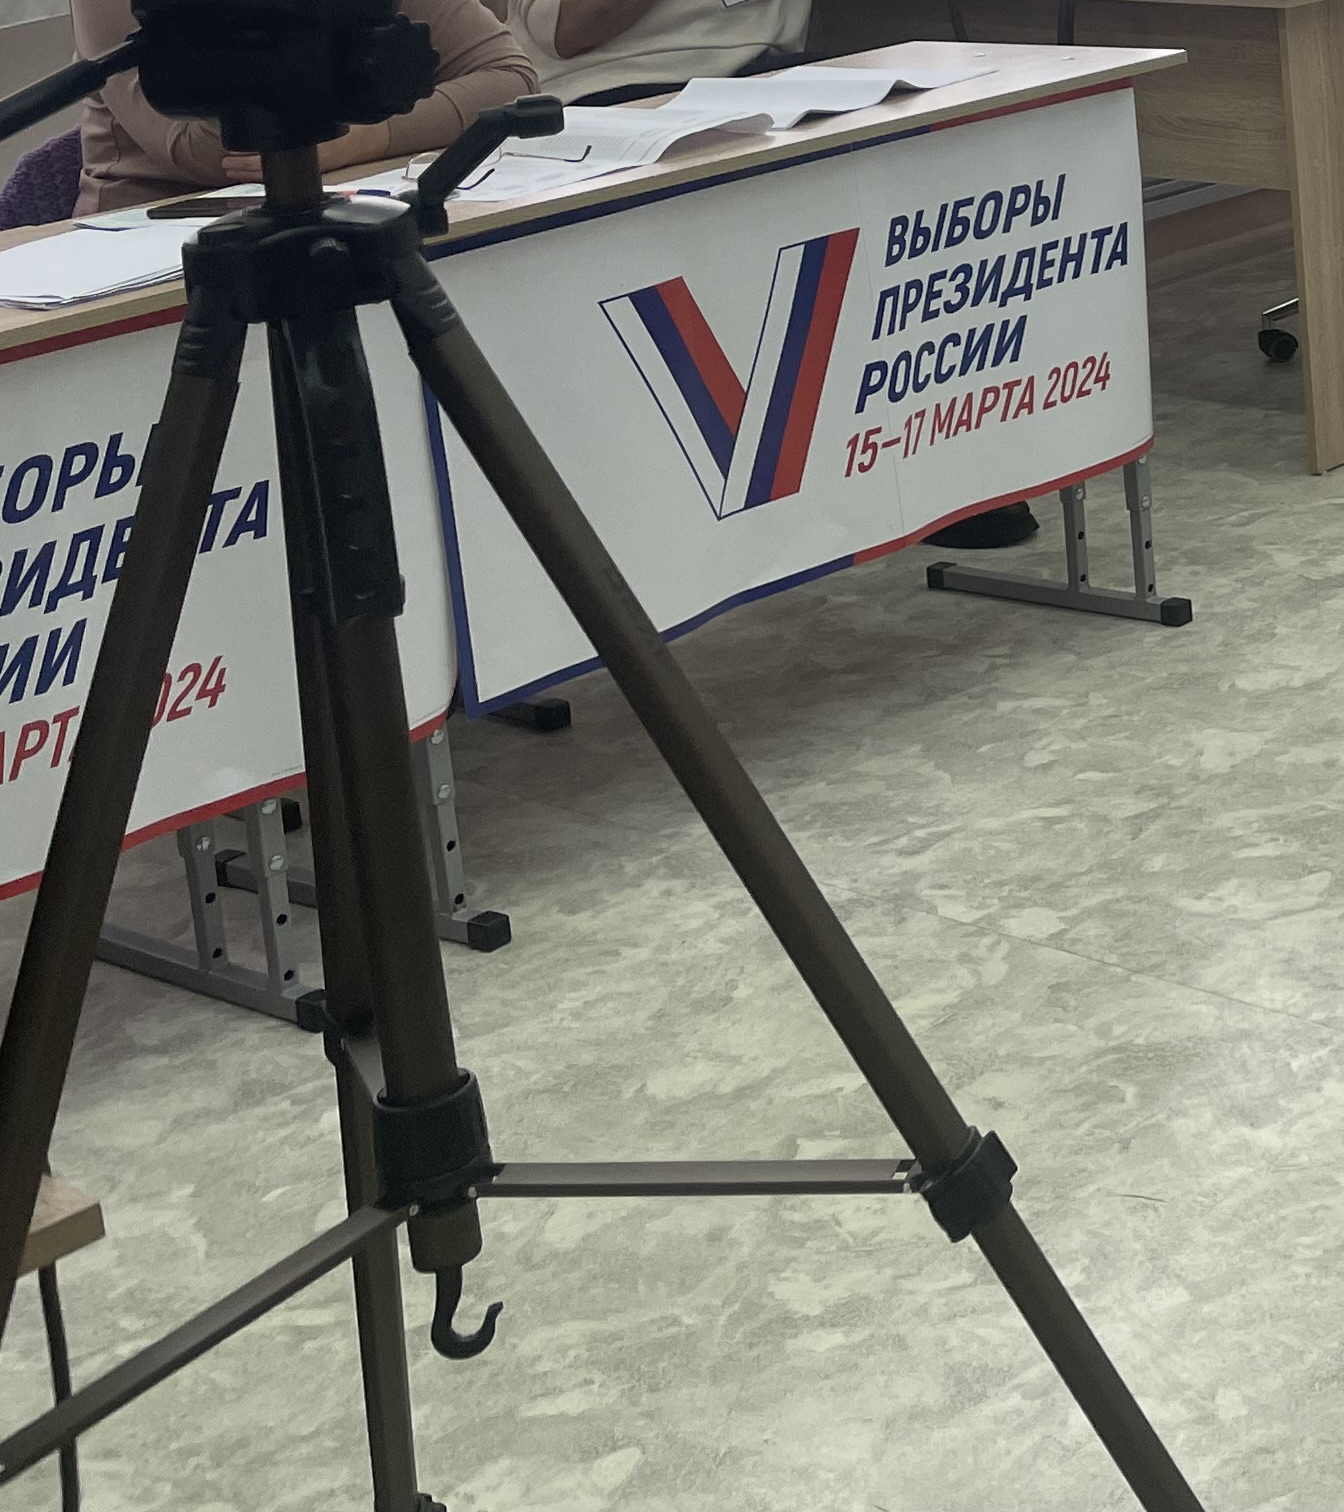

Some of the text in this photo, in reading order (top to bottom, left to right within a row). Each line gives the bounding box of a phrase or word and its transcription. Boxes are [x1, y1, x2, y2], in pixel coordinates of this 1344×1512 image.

[884, 173, 1066, 267] ВЫБОРЫ
[872, 221, 1128, 340] ПРЕЗИДЕНТА
[855, 314, 1028, 414] РОССИИ
[929, 375, 1034, 446] МАРТА
[1042, 351, 1111, 410] 2024
[0, 424, 158, 524] ОРЫ
[0, 480, 270, 617] ИДЕТА
[0, 706, 80, 785] РТ
